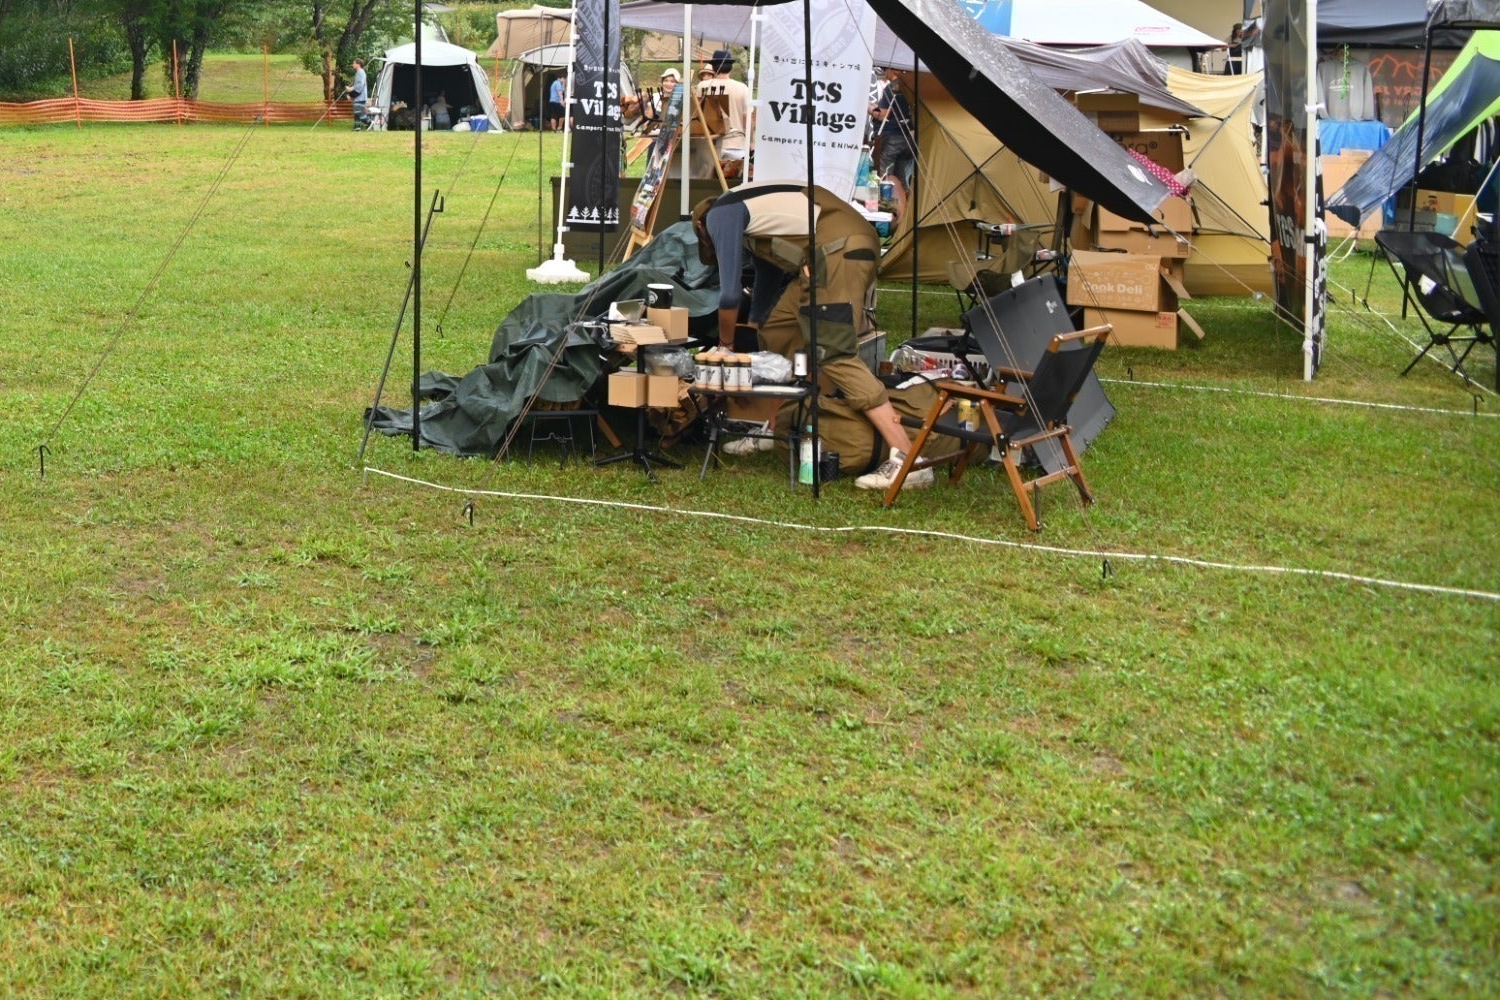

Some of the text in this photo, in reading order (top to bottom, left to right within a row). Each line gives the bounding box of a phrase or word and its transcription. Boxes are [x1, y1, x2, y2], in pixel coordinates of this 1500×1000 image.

[790, 78, 842, 104] TCS
[581, 98, 620, 121] Vilag
[768, 101, 857, 133] Village
[830, 141, 860, 151] ENIWA
[1116, 283, 1143, 295] Deli
